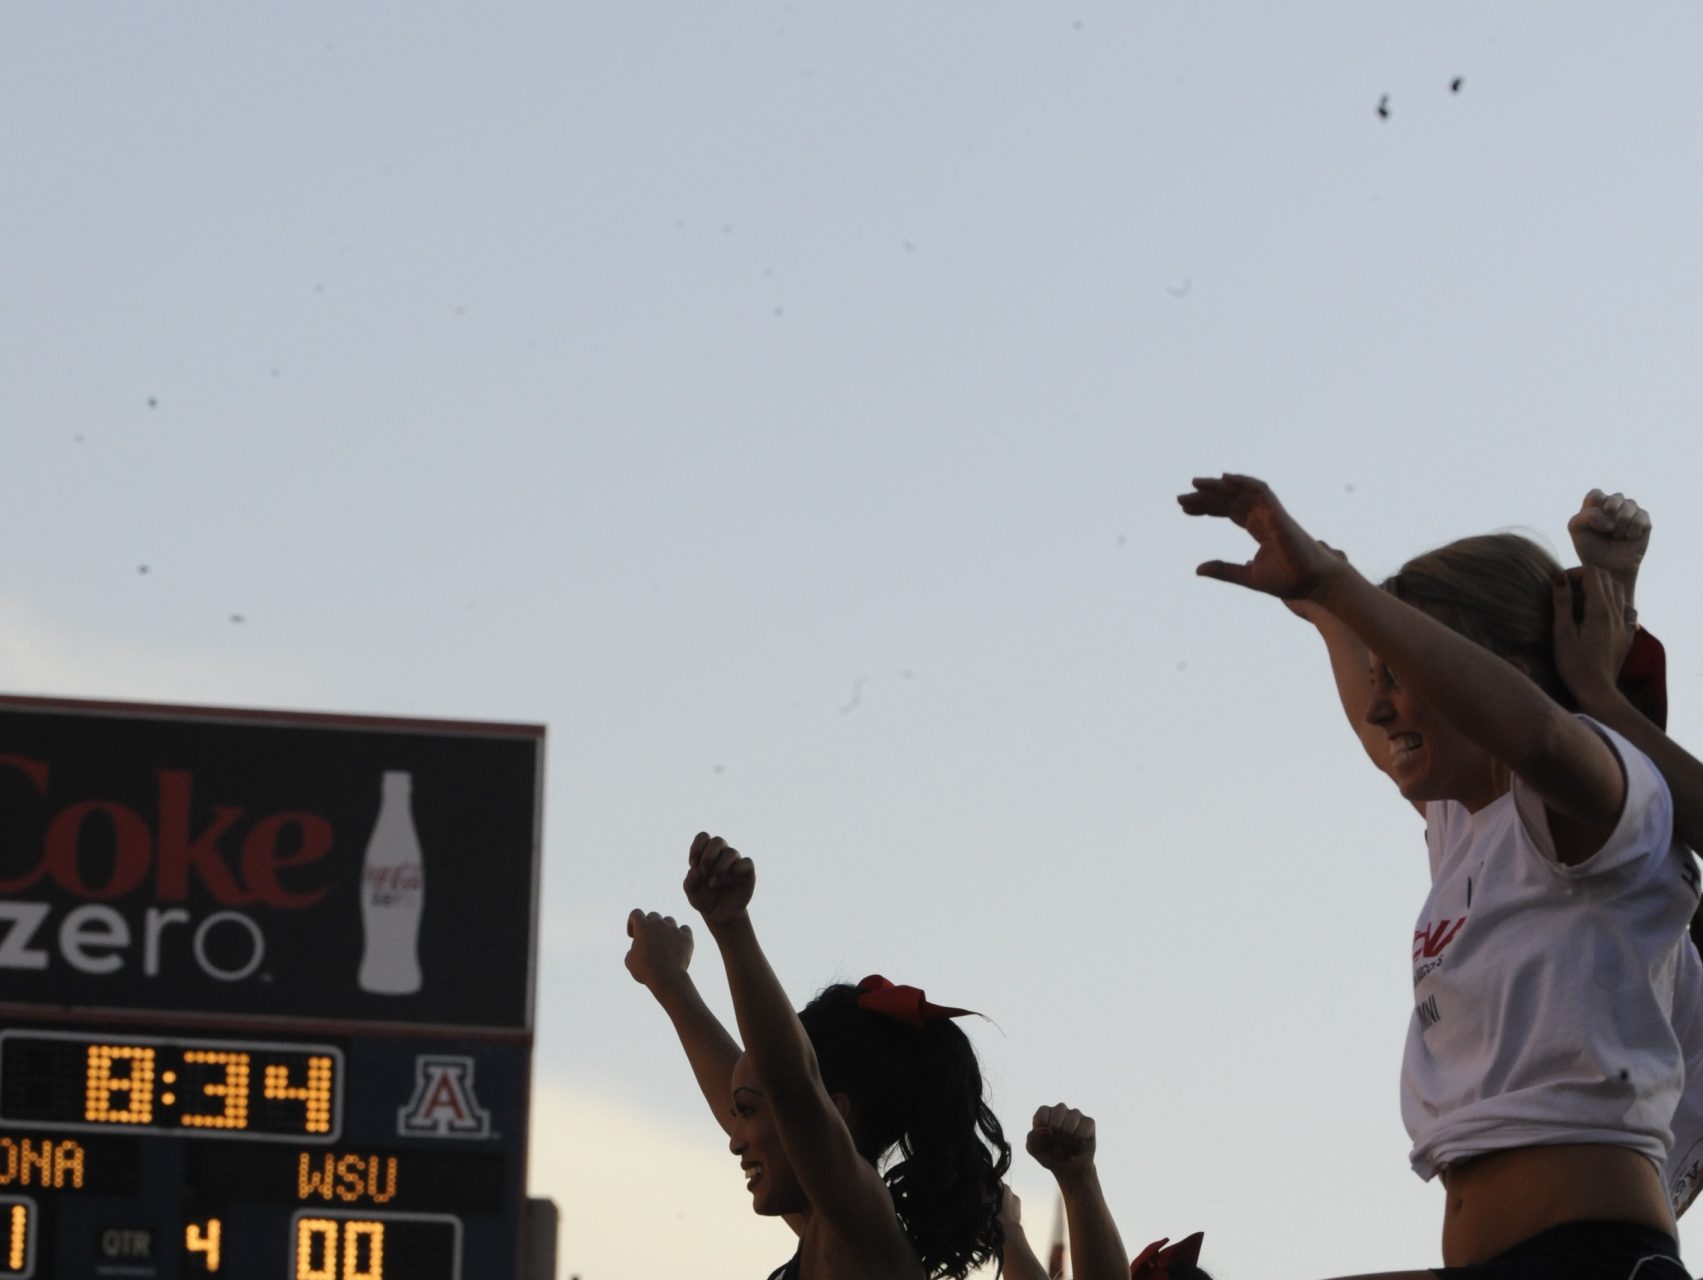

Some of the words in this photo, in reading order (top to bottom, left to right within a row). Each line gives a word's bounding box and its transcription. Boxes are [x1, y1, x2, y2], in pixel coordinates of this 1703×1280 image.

[0, 903, 265, 982] zero
[84, 1044, 333, 1133] 8:34
[298, 1152, 398, 1203] WSU
[185, 1217, 222, 1273] 4
